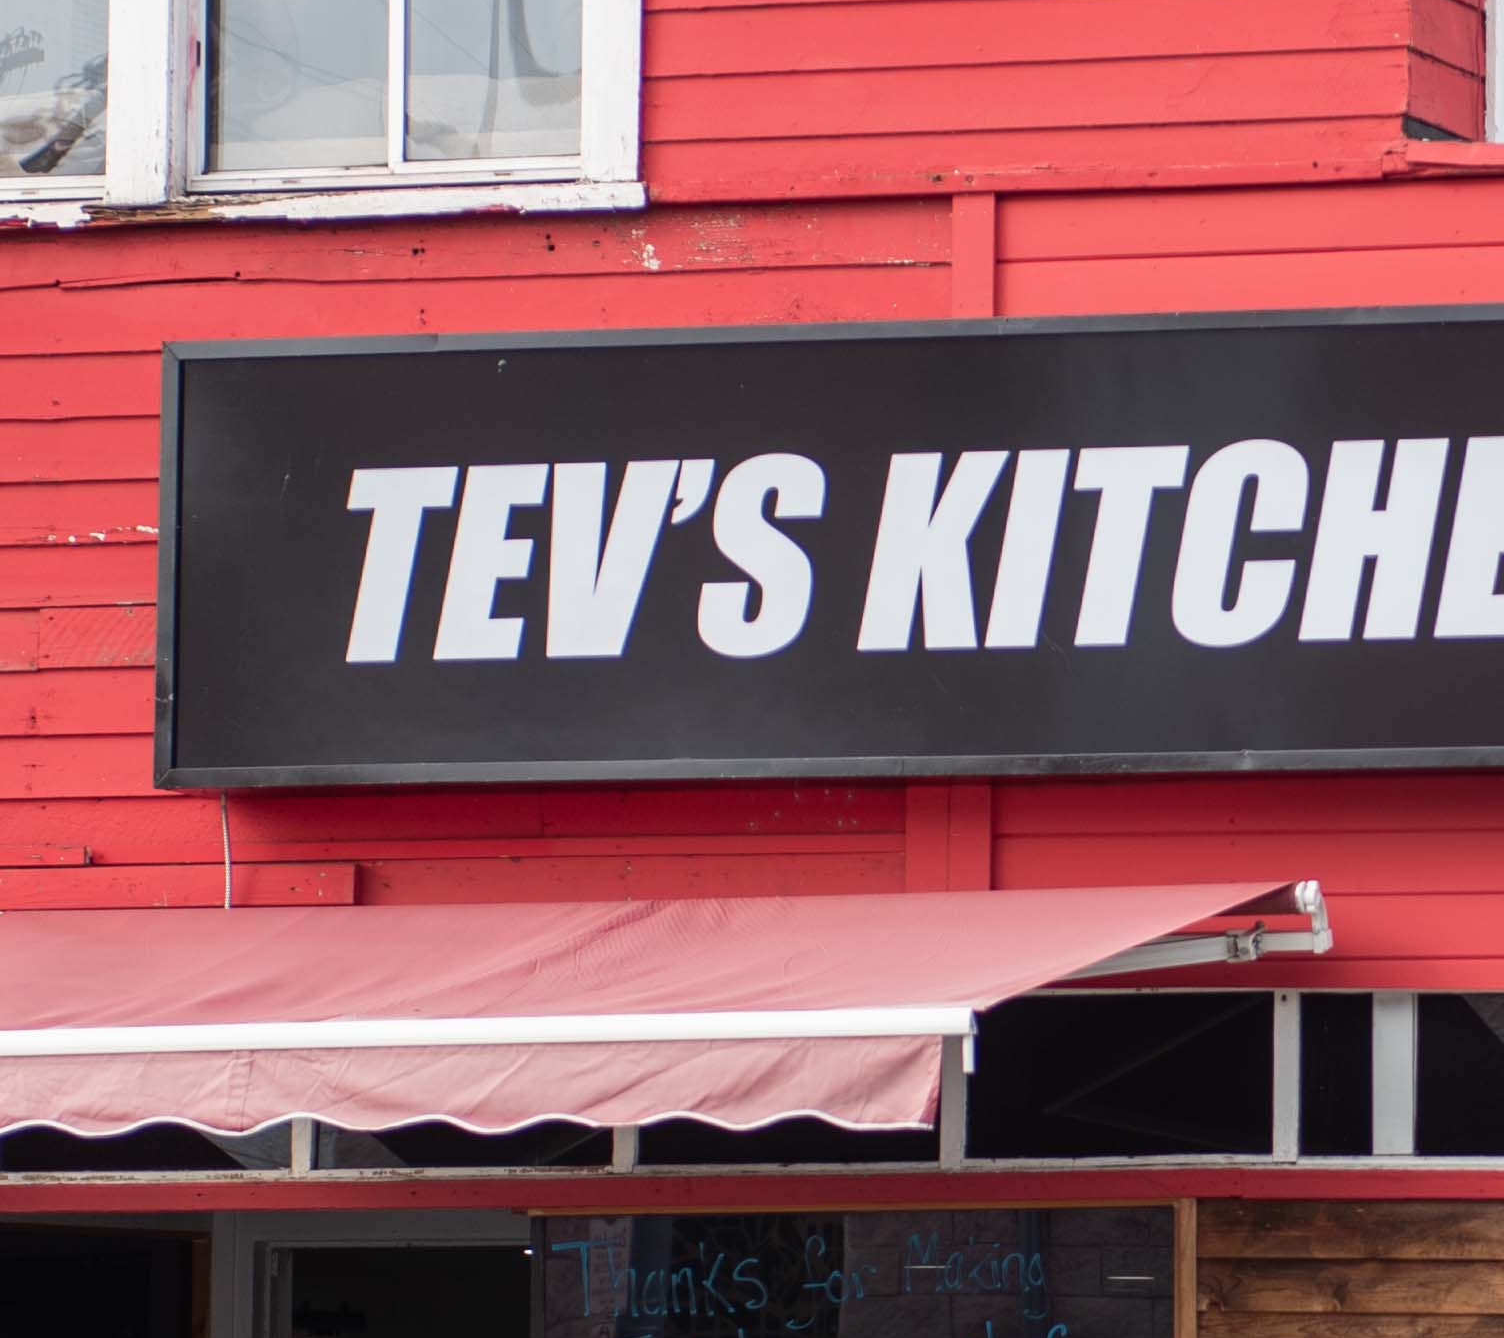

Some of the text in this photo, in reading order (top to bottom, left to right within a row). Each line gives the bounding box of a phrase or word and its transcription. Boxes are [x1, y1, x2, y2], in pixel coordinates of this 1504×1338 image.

[346, 454, 826, 663] TEV'S
[551, 1240, 768, 1318] Thanks
[785, 1234, 877, 1330] for
